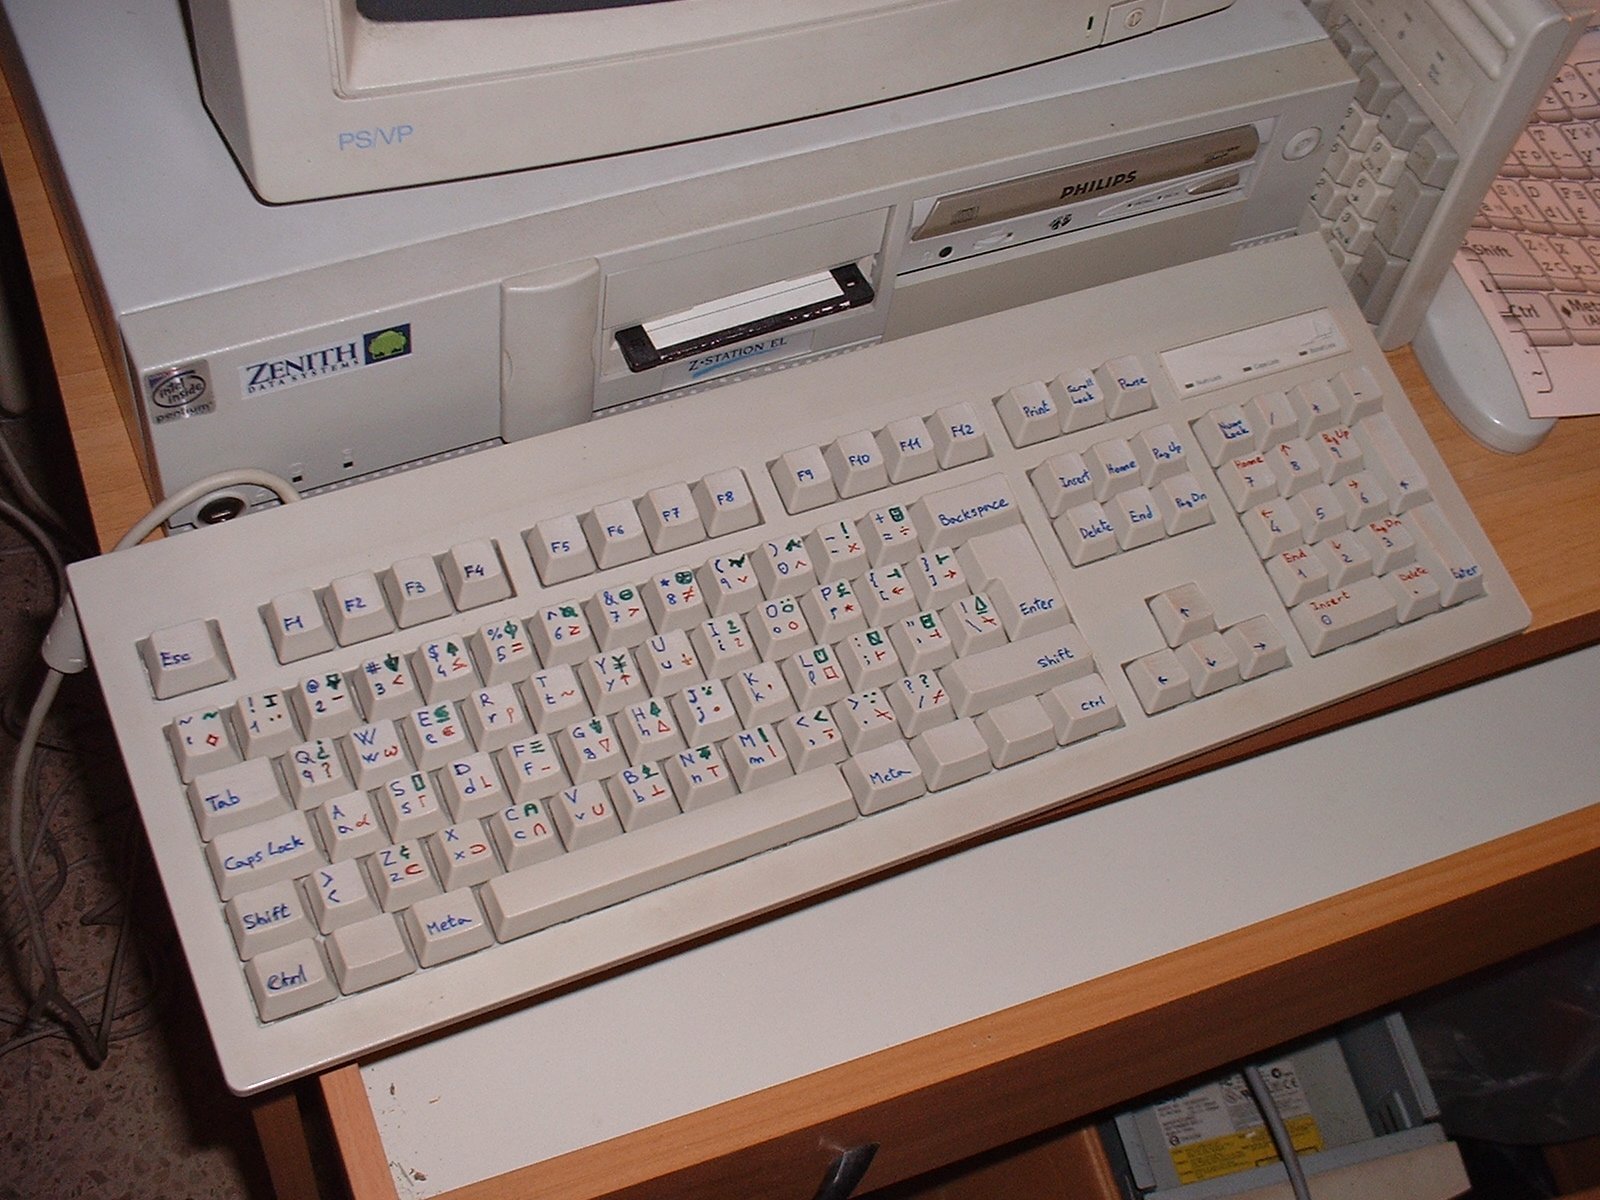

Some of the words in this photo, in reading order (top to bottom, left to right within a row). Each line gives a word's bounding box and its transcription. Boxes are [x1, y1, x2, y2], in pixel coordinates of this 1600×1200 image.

[338, 125, 413, 151] PS/VP
[1060, 170, 1137, 199] PHILIPS
[1528, 186, 1540, 198] D
[1471, 244, 1514, 258] Shift
[770, 336, 787, 350] EL
[245, 342, 357, 386] ZENITH
[248, 379, 286, 394] DATA
[291, 359, 360, 380] SYSTEMS
[1117, 378, 1147, 390] Pause
[156, 403, 209, 424] pentium
[1023, 400, 1050, 417] Print
[951, 424, 974, 437] F12
[899, 437, 921, 451] F11
[848, 454, 870, 466] F10
[1106, 461, 1136, 474] Home
[1234, 457, 1264, 469] Home
[797, 469, 814, 481] F9
[1059, 469, 1090, 488] Insert
[717, 491, 734, 505] F8
[662, 507, 680, 522] F7
[938, 499, 1009, 526] Backspace
[1129, 505, 1153, 523] End
[607, 525, 624, 537] F6
[1079, 520, 1114, 539] Delete
[551, 541, 570, 553] F5
[1282, 549, 1307, 563] End
[464, 564, 484, 578] F4
[405, 581, 426, 596] F3
[344, 597, 366, 612] F2
[1019, 598, 1054, 615] Enter
[1310, 591, 1350, 610] Insert
[284, 616, 304, 631] F1
[160, 652, 191, 667] Esc
[1037, 647, 1074, 668] Shift
[869, 768, 911, 784] Meta
[205, 789, 240, 811] Tab
[224, 851, 263, 870] Caps
[267, 835, 304, 855] Lock
[243, 903, 291, 929] Shift
[427, 914, 472, 935] Meta
[267, 964, 307, 990] Ctrl
